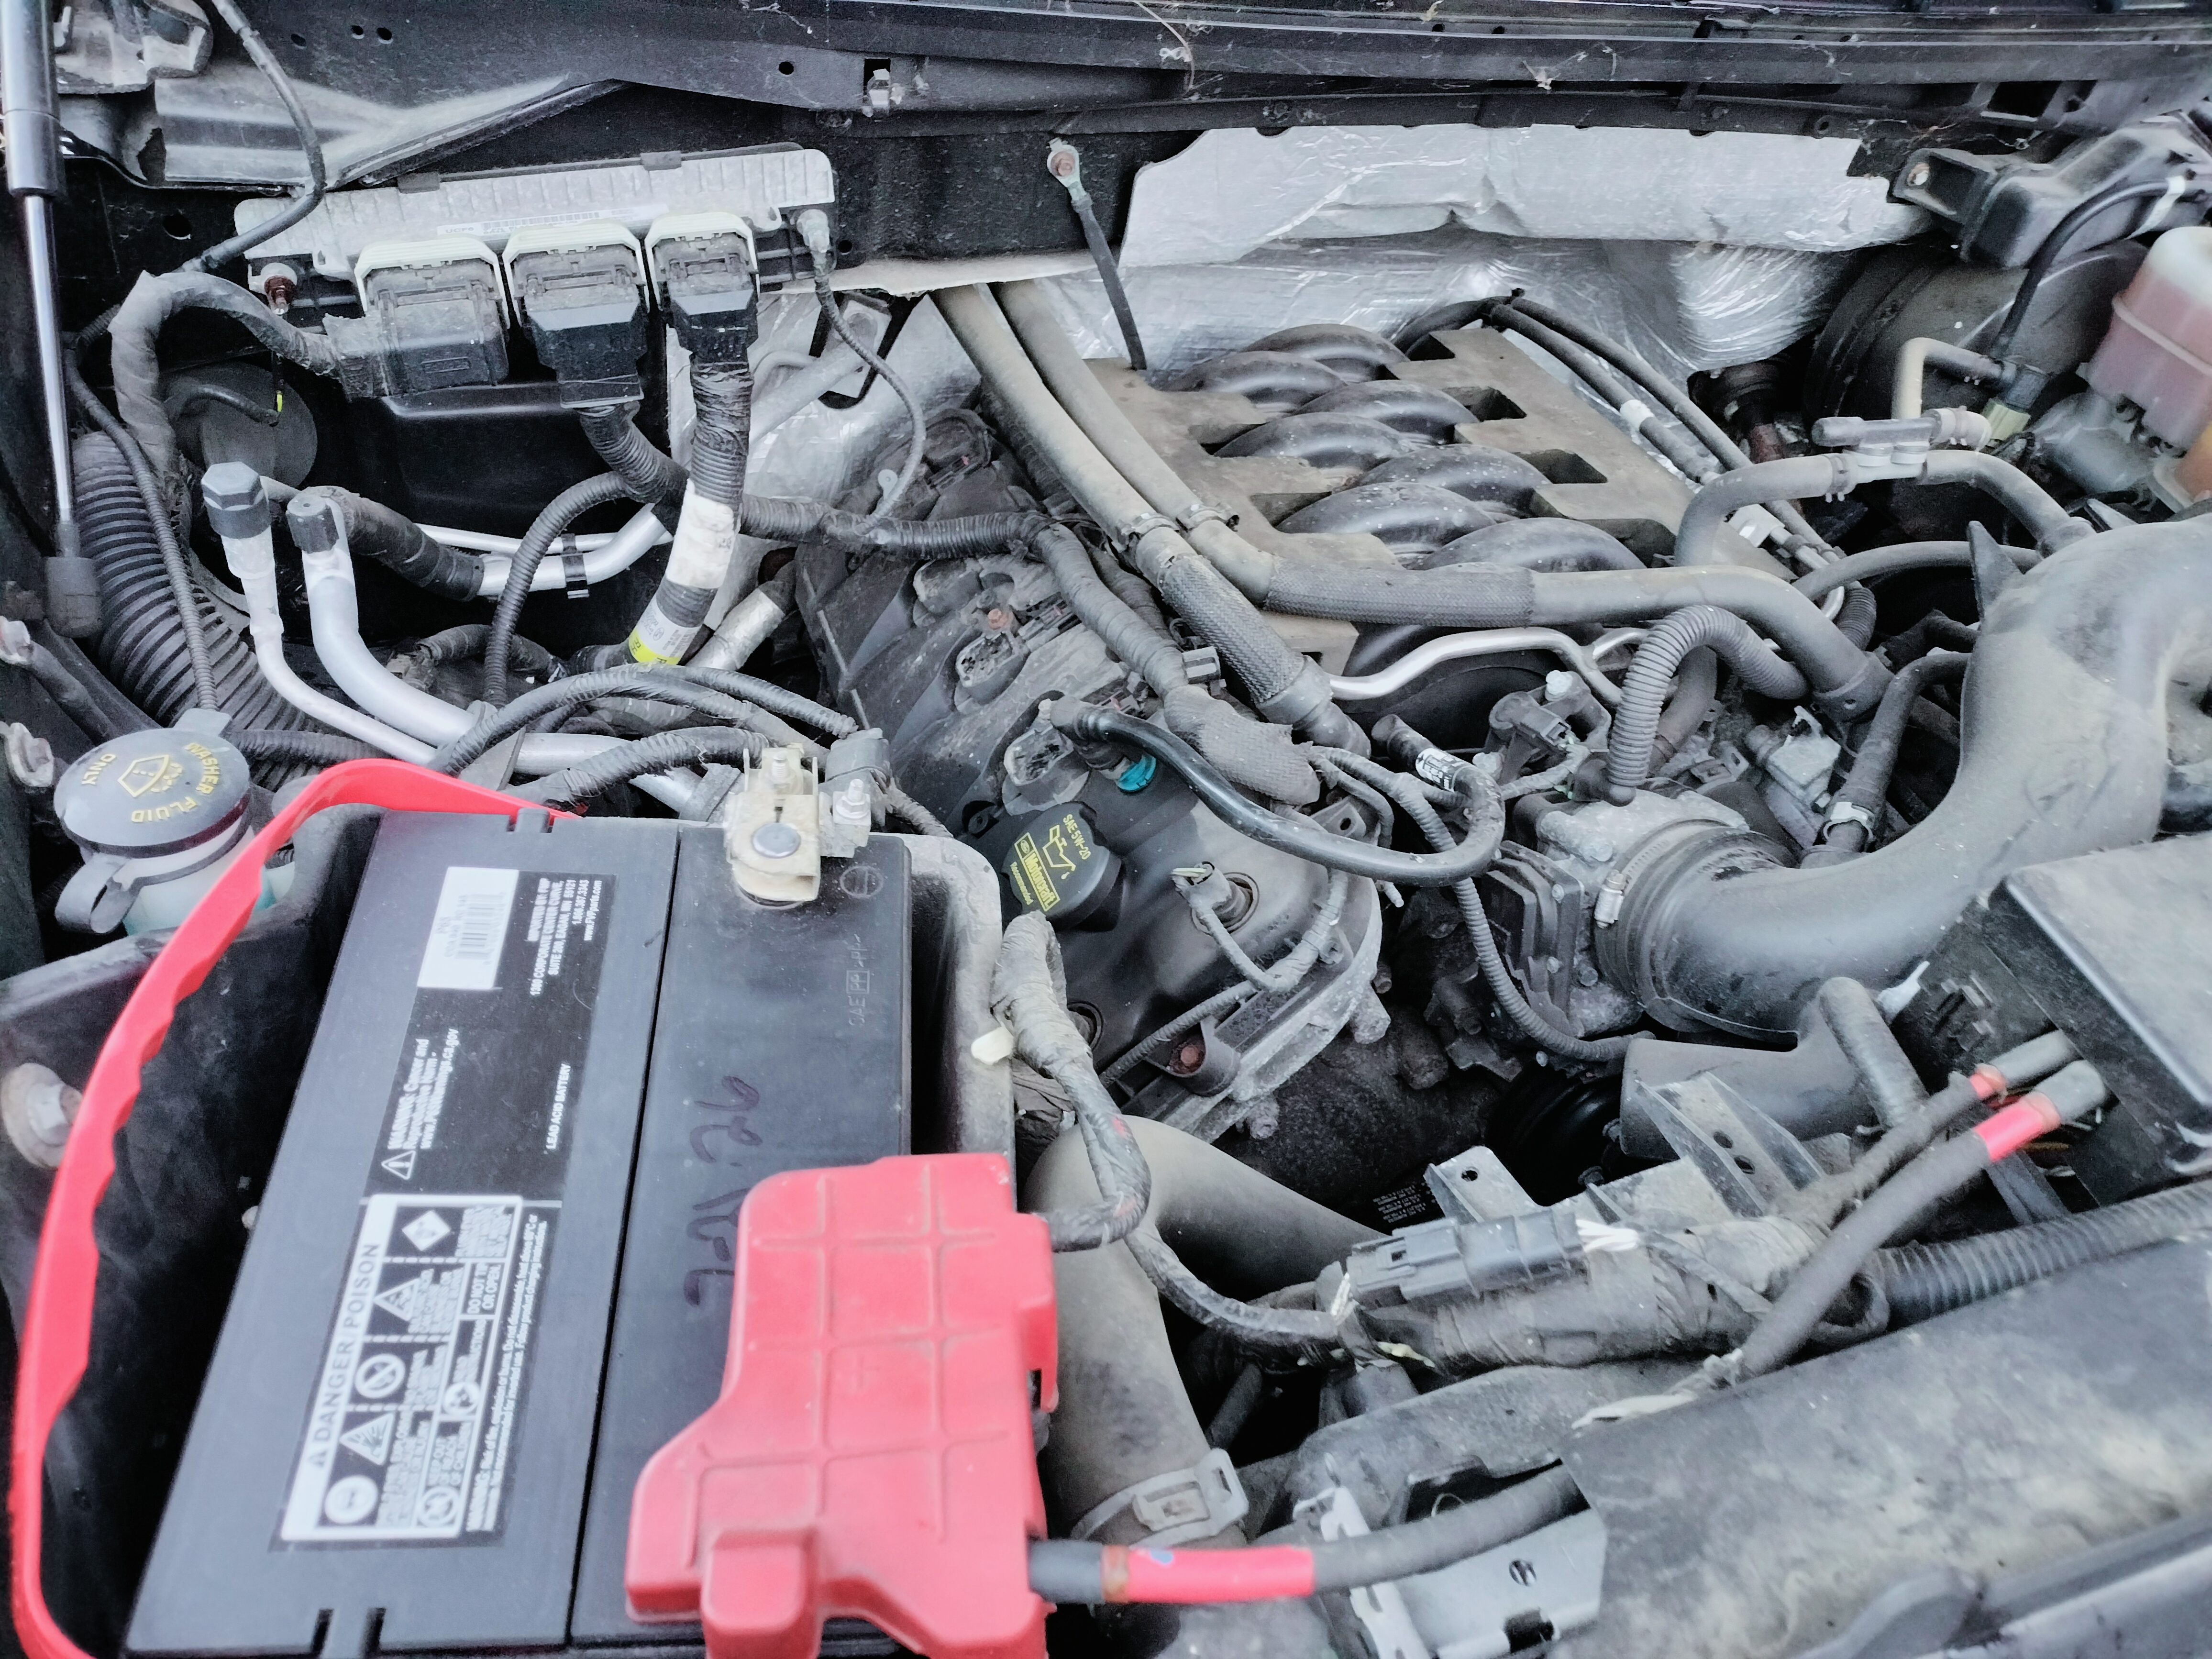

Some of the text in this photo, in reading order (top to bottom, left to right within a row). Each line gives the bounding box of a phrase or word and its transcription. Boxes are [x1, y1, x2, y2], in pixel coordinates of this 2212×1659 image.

[81, 753, 116, 785] ONLY
[131, 742, 221, 824] WASHER FLUID
[1063, 813, 1091, 860] SAE 5W-20
[1024, 852, 1057, 907] Motorcraft
[547, 953, 562, 975] SUITE
[563, 879, 576, 897] 55121
[532, 934, 553, 978] CORPORATE
[411, 1039, 429, 1056] and
[545, 1063, 571, 1149] LEAD ACID BATTERY
[467, 1299, 482, 1313] DO
[470, 1278, 486, 1297] NOT
[481, 1294, 496, 1308] OR
